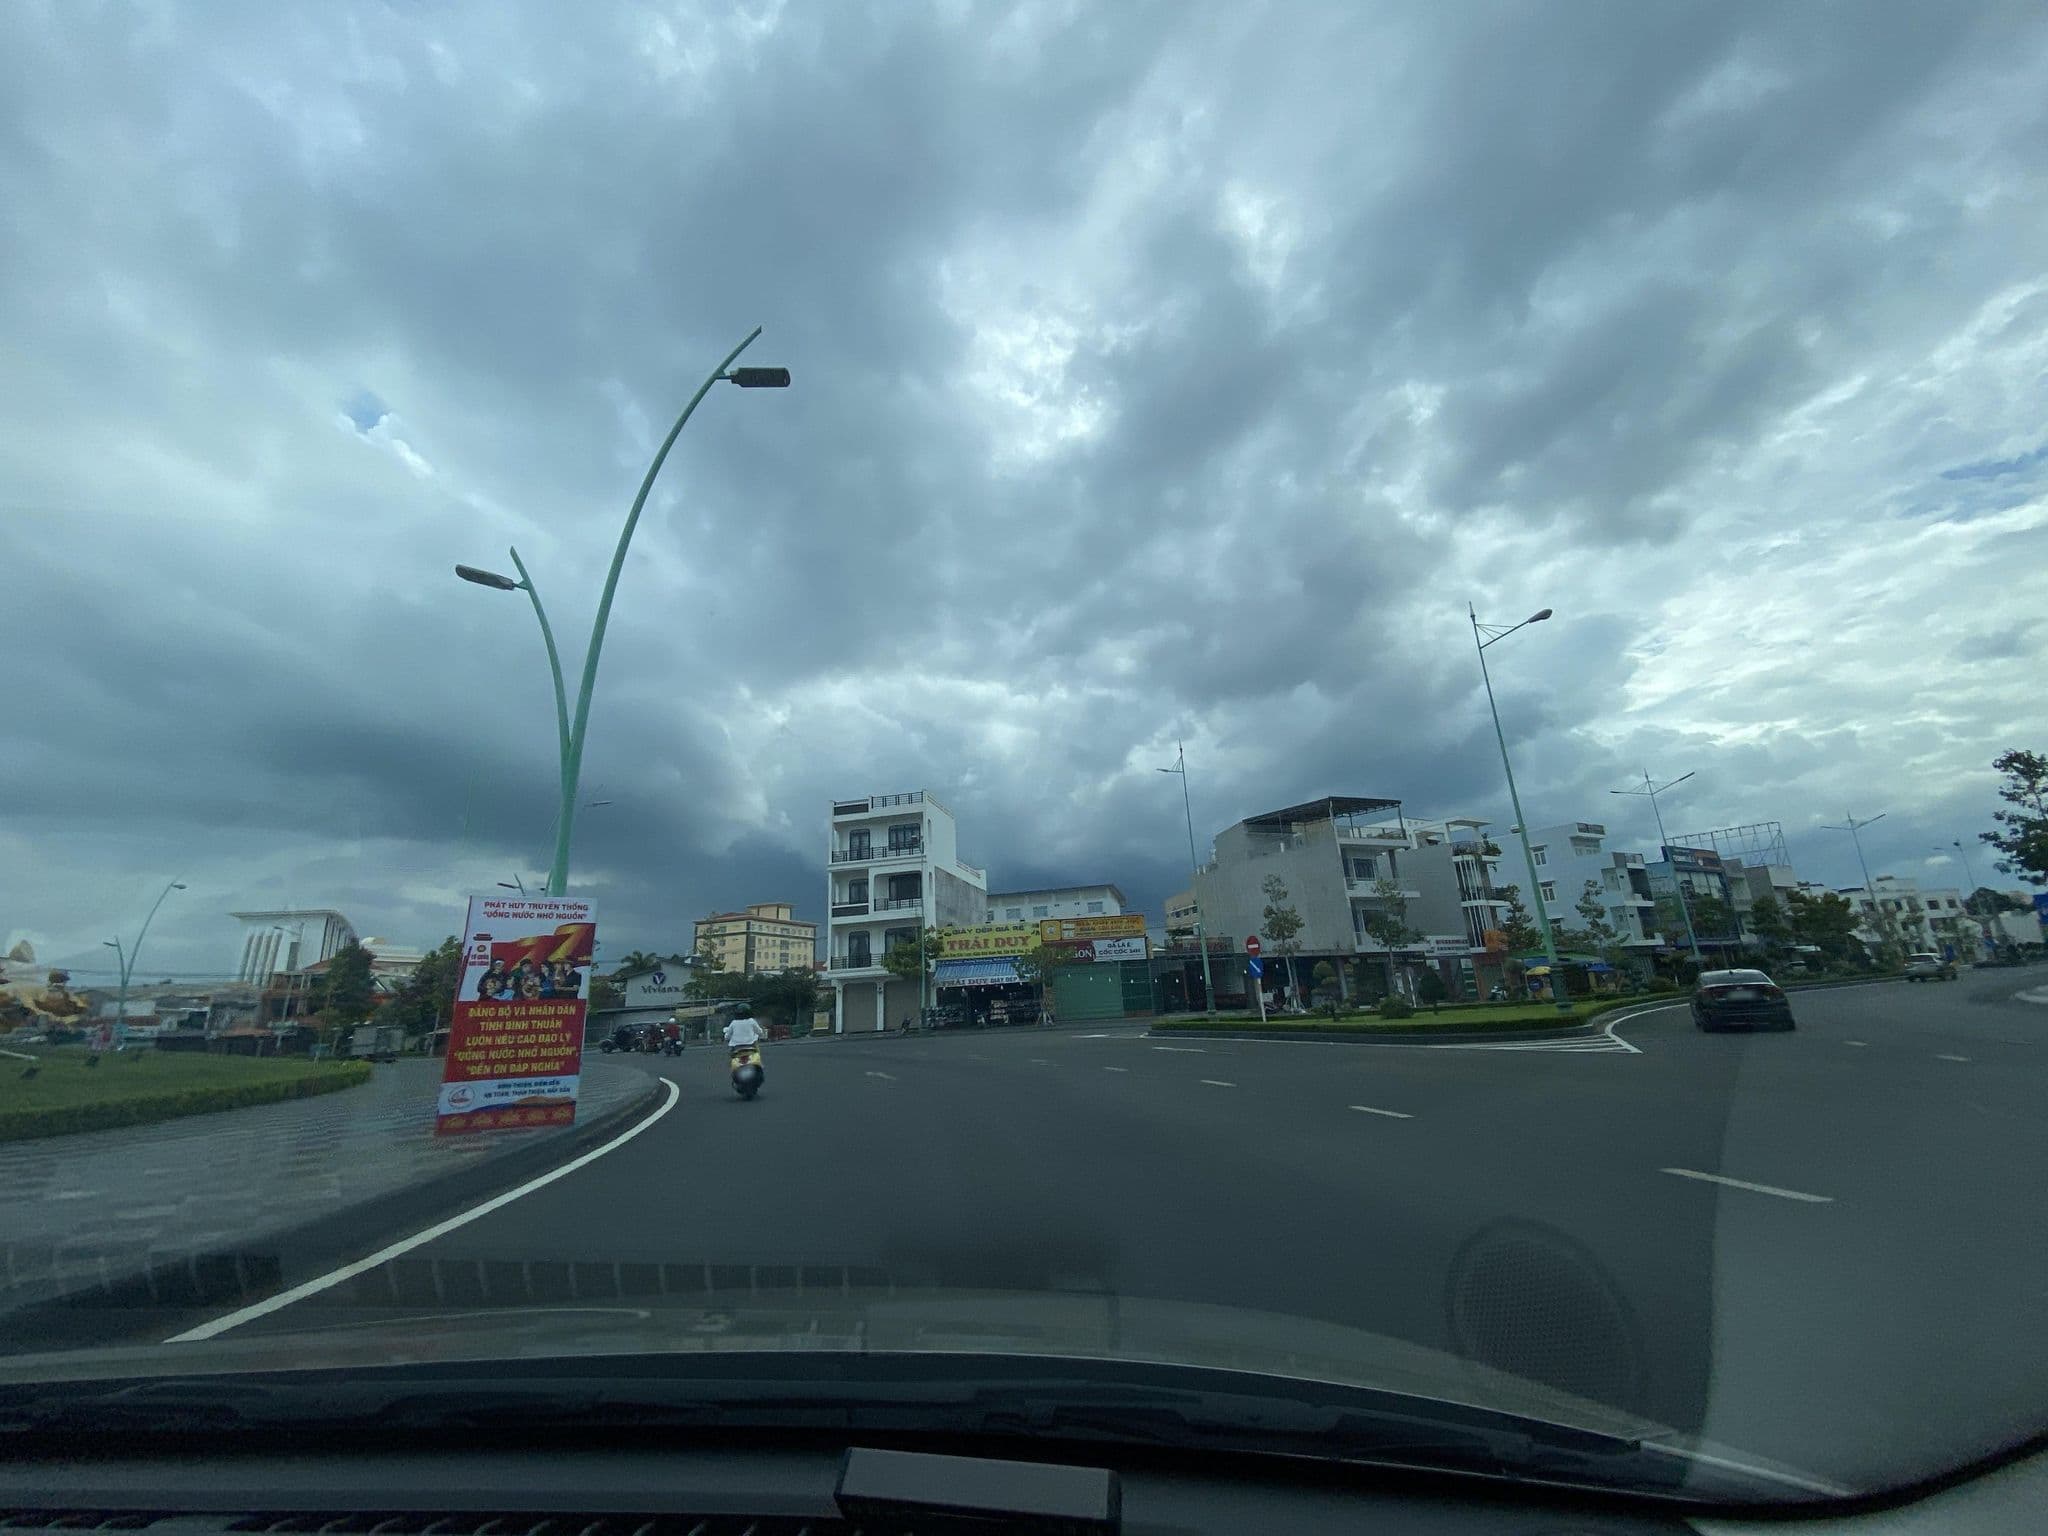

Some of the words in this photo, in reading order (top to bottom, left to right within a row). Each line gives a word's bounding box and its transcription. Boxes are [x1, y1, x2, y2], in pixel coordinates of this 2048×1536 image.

[484, 901, 506, 909] PHÁT
[528, 901, 560, 910] TRUYỀN
[562, 901, 589, 911] THỐNG
[537, 911, 554, 919] NHỚ
[994, 936, 1032, 948] DUY
[497, 1005, 512, 1019] BỘ
[528, 1003, 555, 1016] NHÂN
[557, 1003, 576, 1015] DÂN
[516, 1034, 536, 1044] CAO
[488, 1048, 515, 1060] NƯỚC
[517, 1046, 537, 1058] NHỚ
